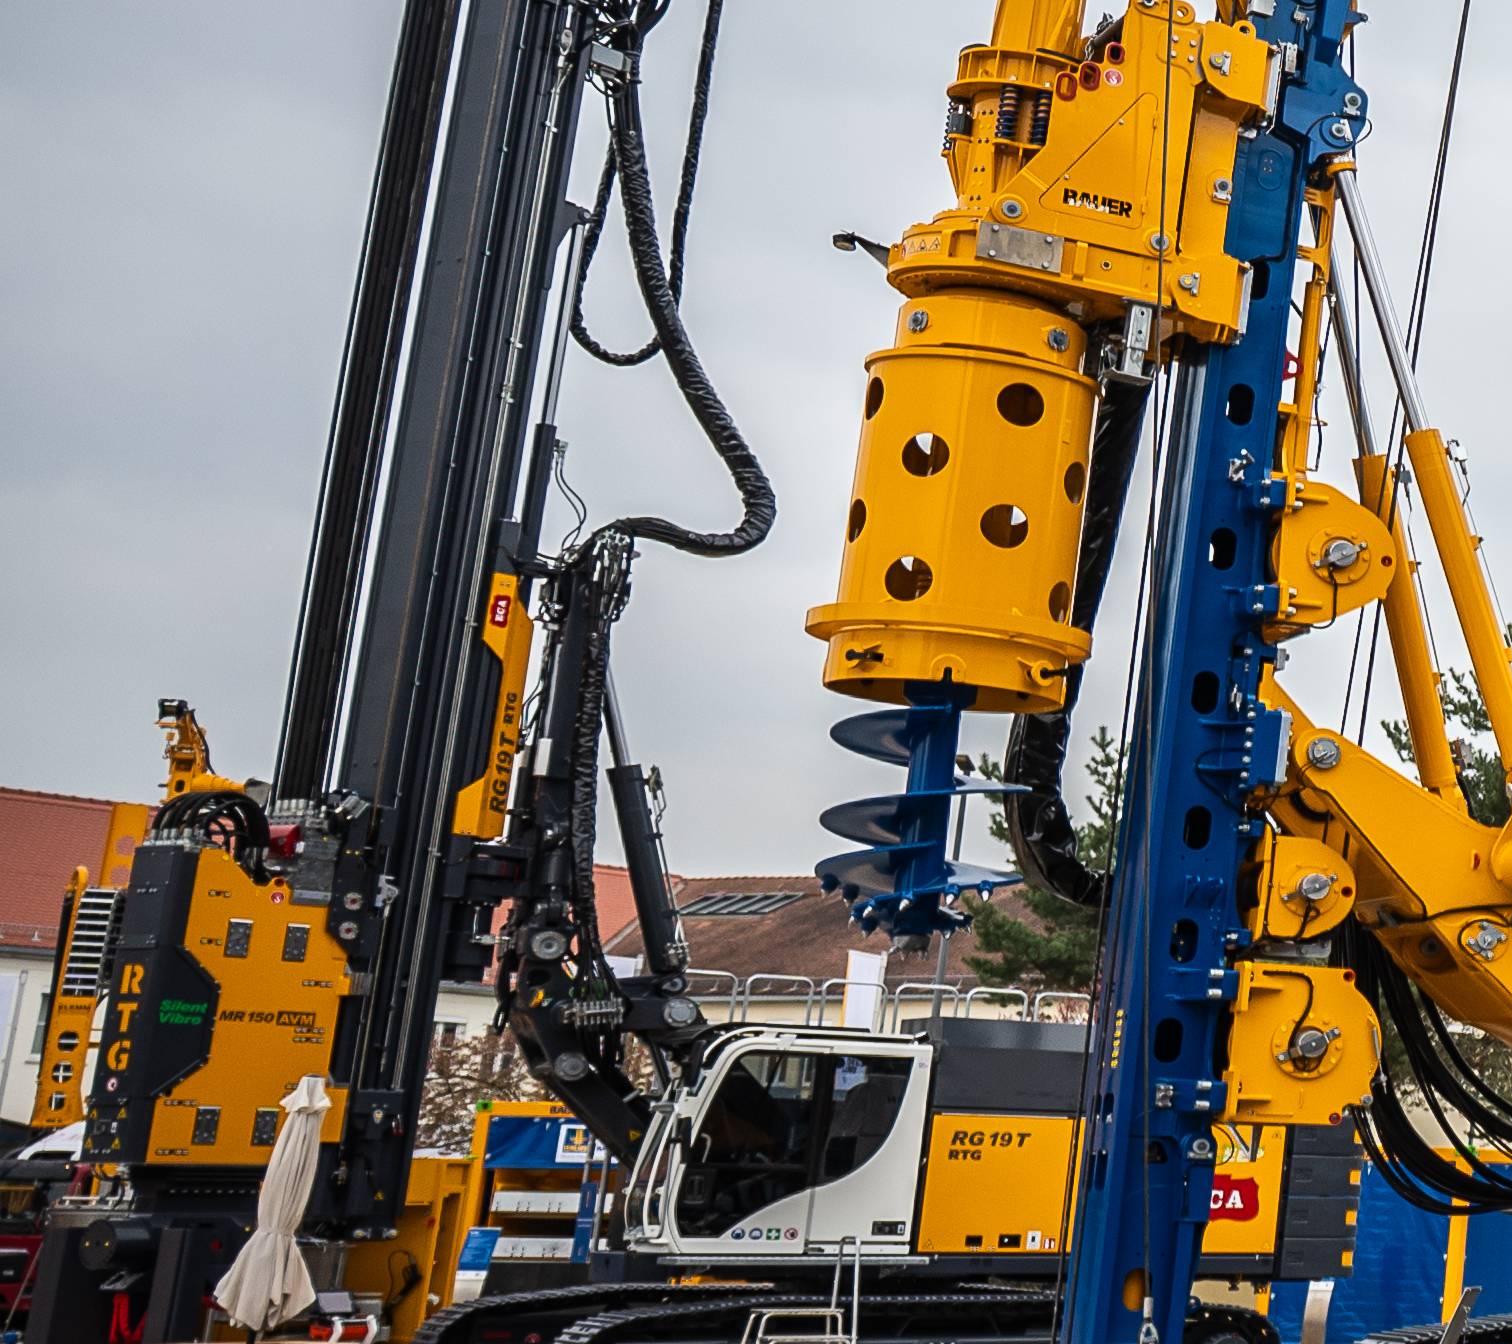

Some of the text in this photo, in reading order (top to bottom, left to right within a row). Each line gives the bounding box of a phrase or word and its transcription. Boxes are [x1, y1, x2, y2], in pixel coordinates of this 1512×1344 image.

[1062, 187, 1133, 219] BAUER
[503, 691, 517, 724] RTG
[496, 750, 513, 776] 19
[490, 779, 507, 814] RG
[159, 999, 208, 1014] Silent
[159, 1011, 201, 1025] Vibro
[219, 1010, 314, 1026] MR 150 AVM
[951, 1130, 1031, 1147] RG 19 T
[948, 1149, 982, 1161] RTG
[1210, 1189, 1244, 1209] CA
